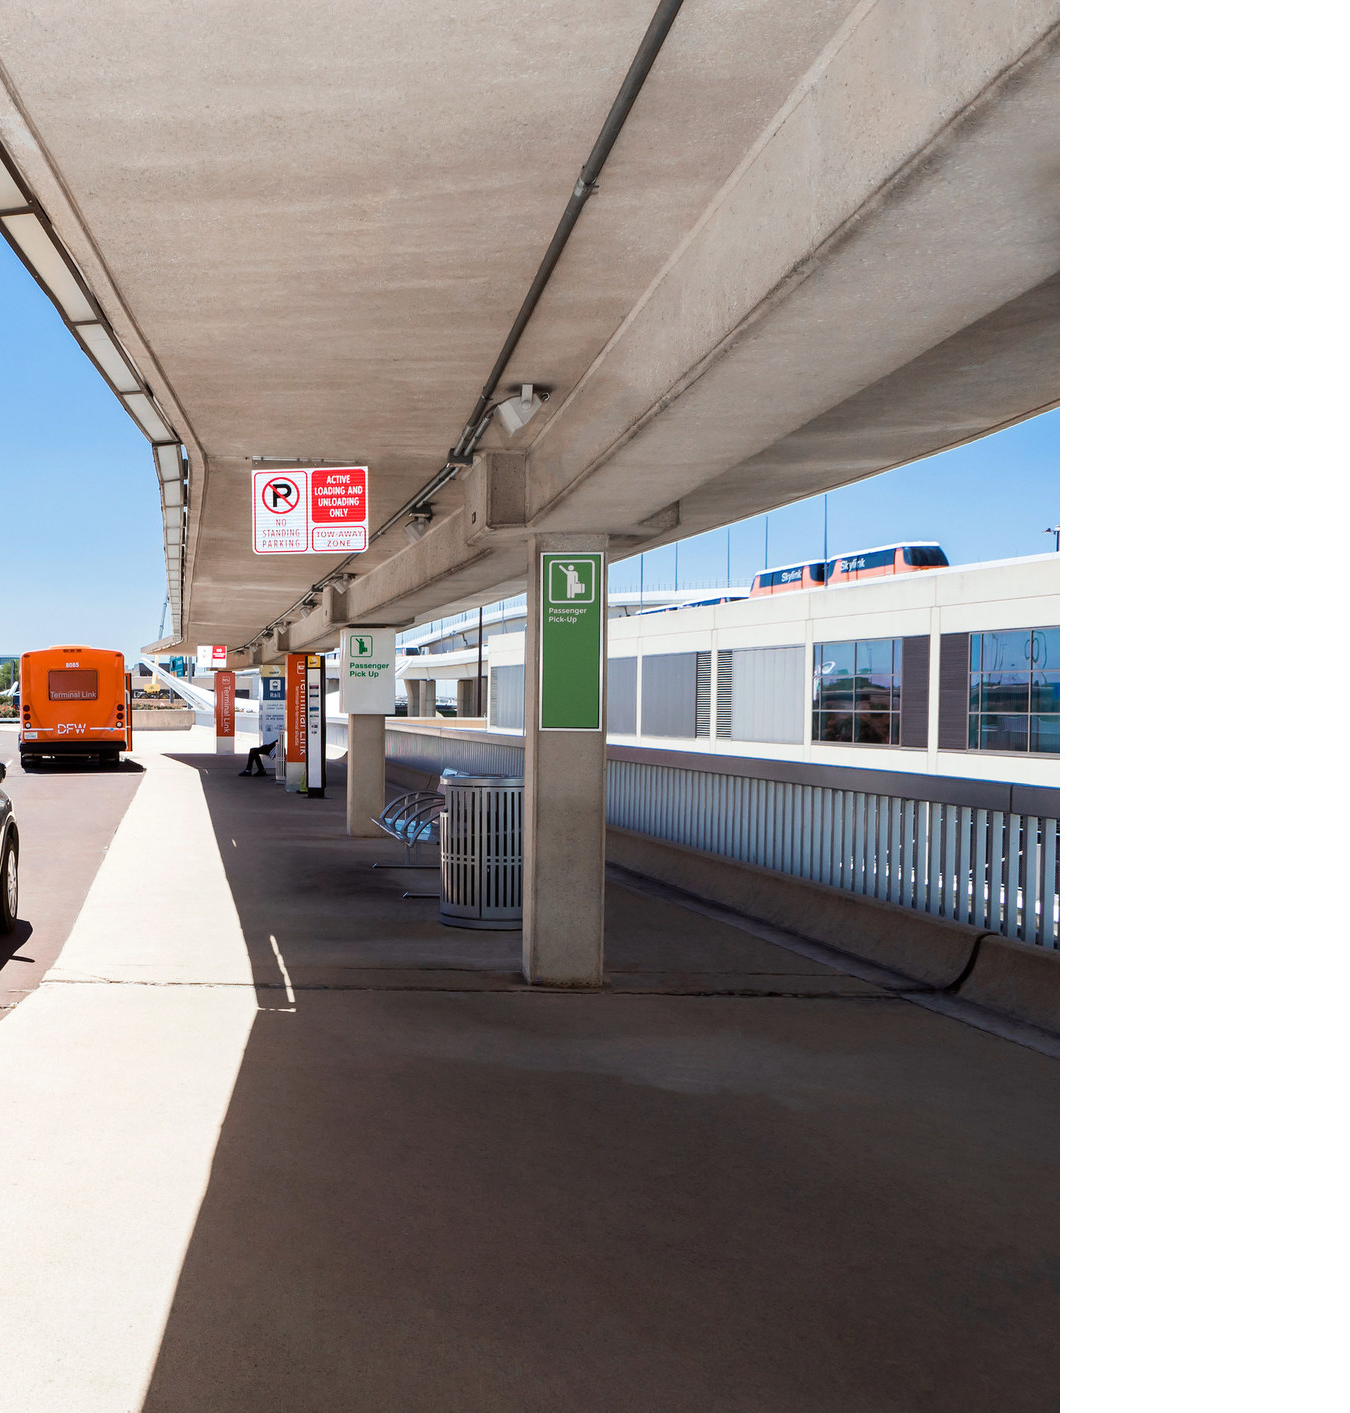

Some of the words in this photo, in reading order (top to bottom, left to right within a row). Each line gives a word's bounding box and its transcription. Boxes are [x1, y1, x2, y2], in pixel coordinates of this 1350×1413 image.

[326, 475, 350, 484] ACTIVE
[314, 486, 345, 495] LOADING
[347, 486, 363, 495] AND
[318, 497, 359, 507] UNLOADING
[329, 508, 349, 517] ONLY
[262, 529, 300, 538] STANDING
[316, 530, 363, 538] TOW-AWAY
[262, 539, 300, 548] PARKING
[548, 607, 587, 615] Passenger
[548, 616, 578, 624] Pick-Up
[349, 662, 390, 670] Passenger
[349, 670, 366, 678] Pick
[368, 670, 379, 678] Up
[57, 723, 87, 735] DFW
